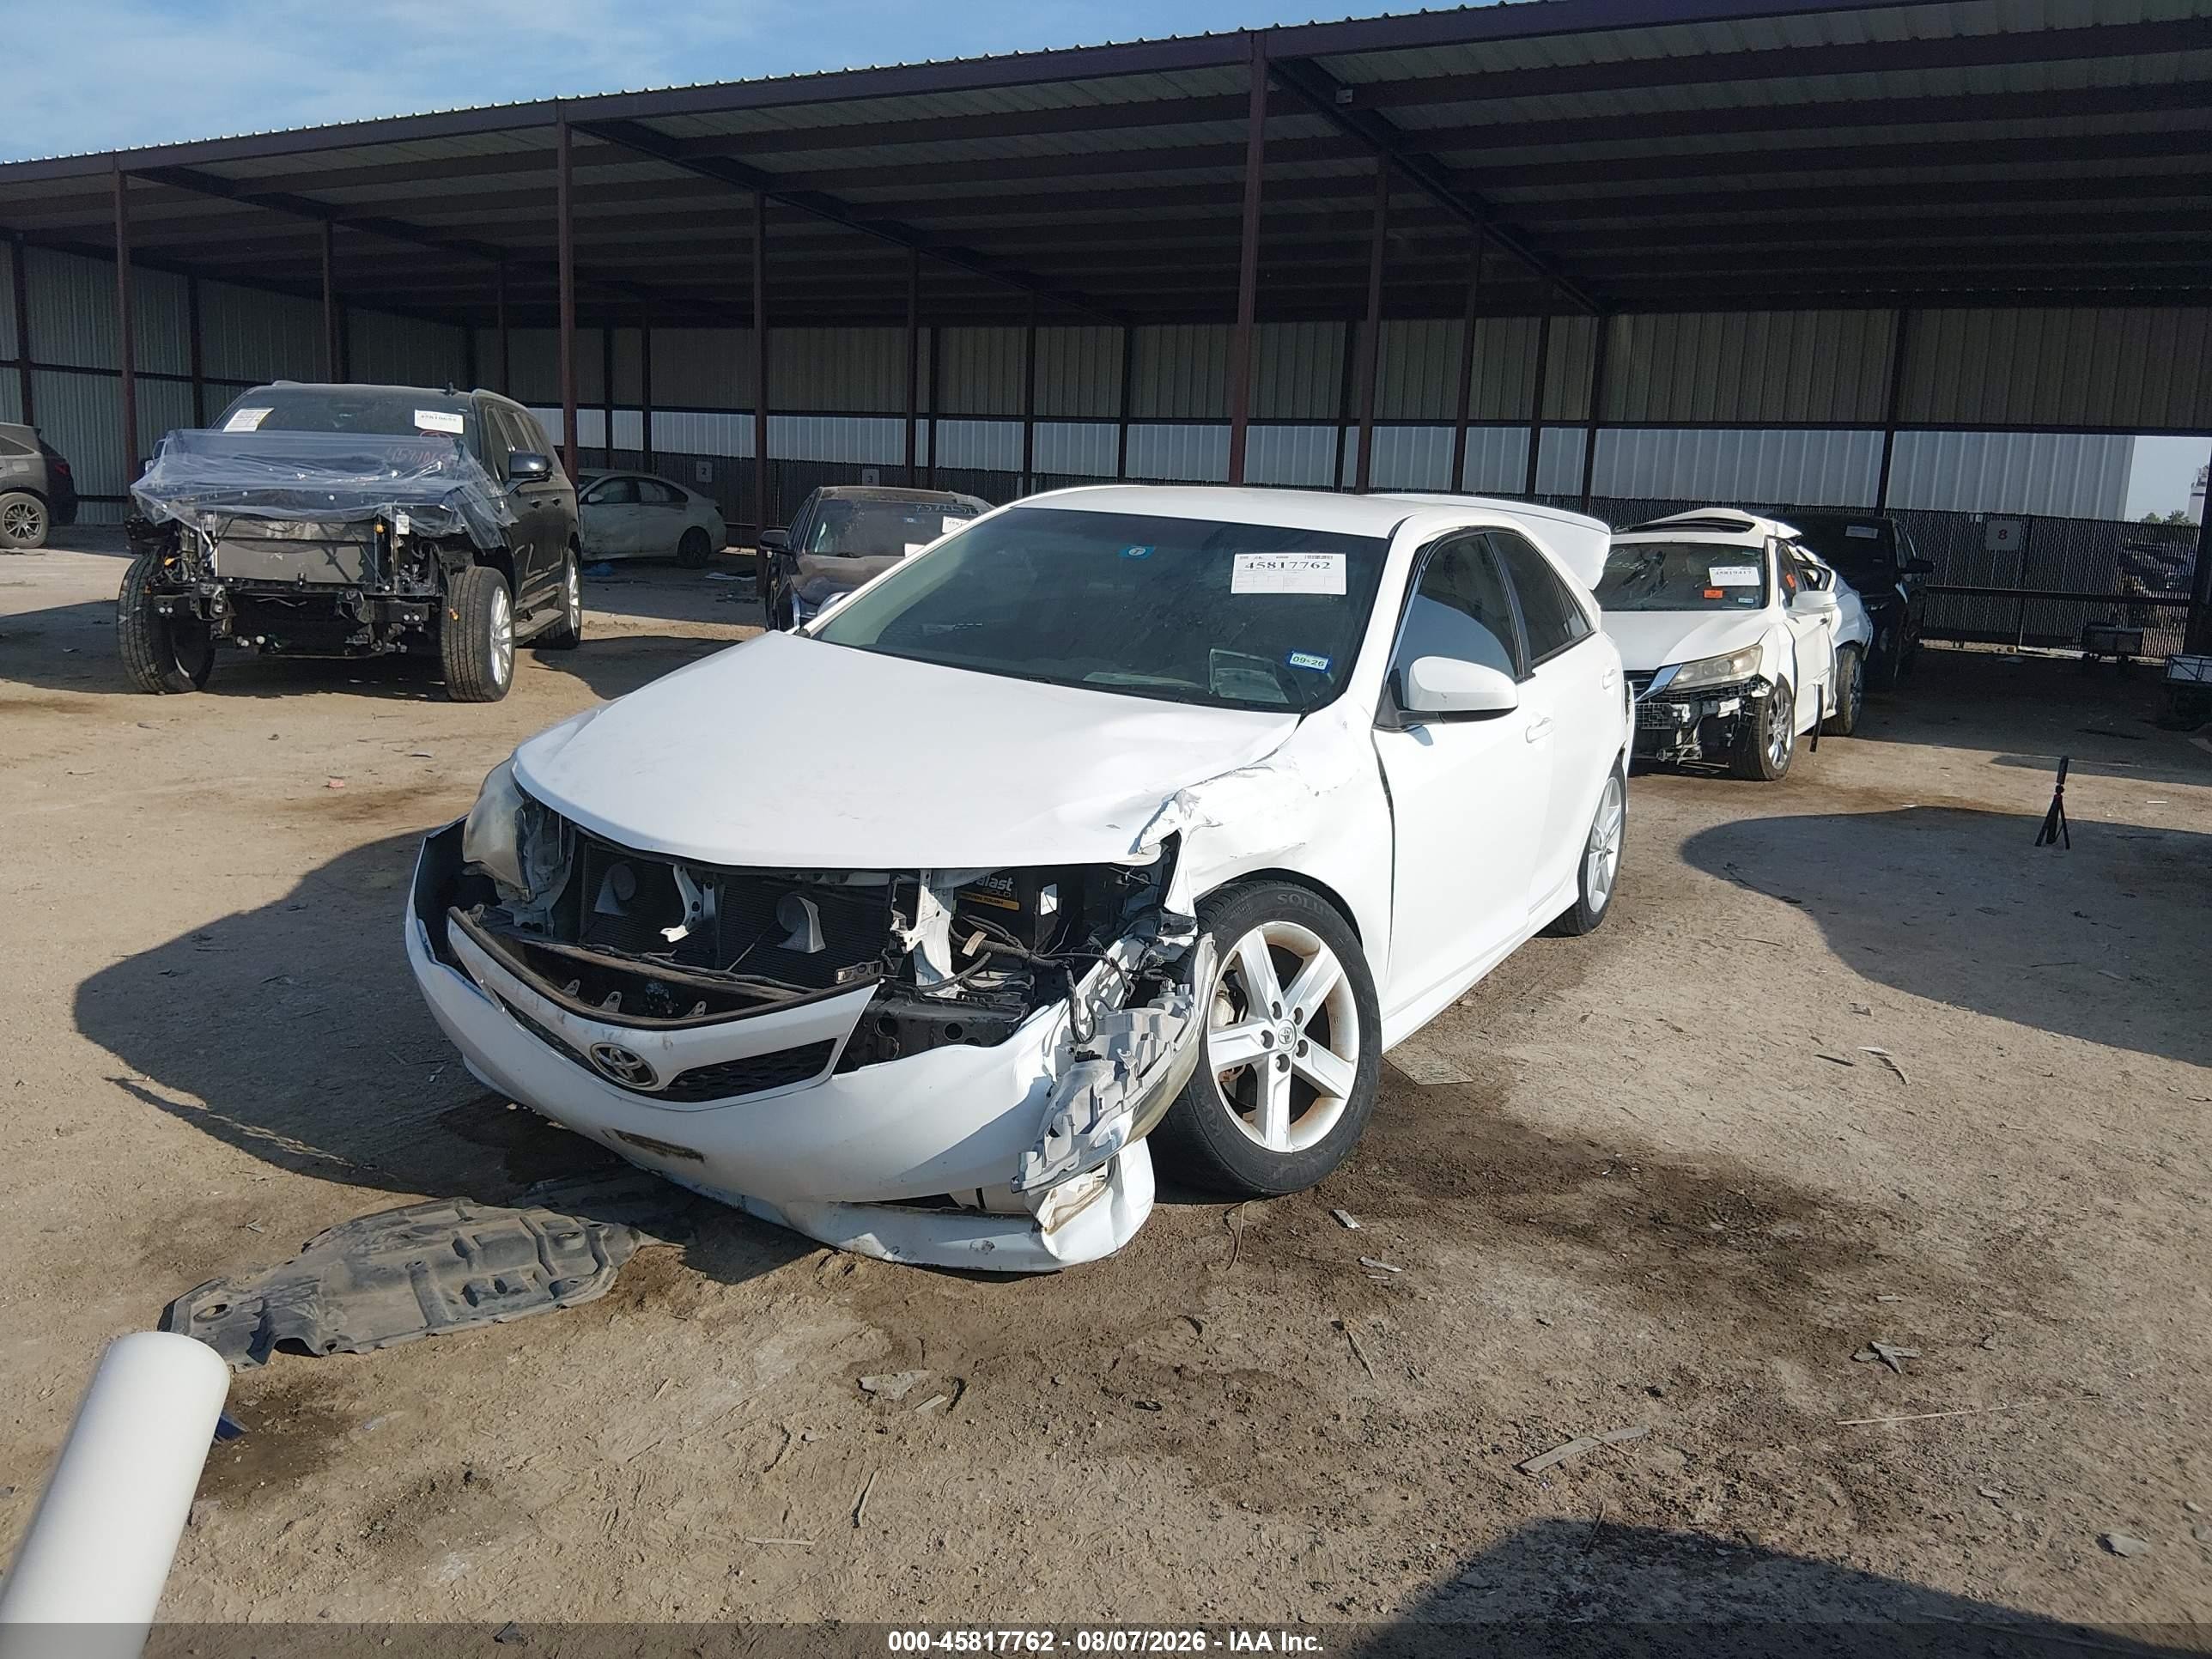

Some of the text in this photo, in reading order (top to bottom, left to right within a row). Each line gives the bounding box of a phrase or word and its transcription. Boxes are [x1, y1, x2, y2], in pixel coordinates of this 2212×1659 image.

[702, 467, 707, 476] 2
[866, 475, 873, 483] 3
[1998, 529, 2008, 540] 8
